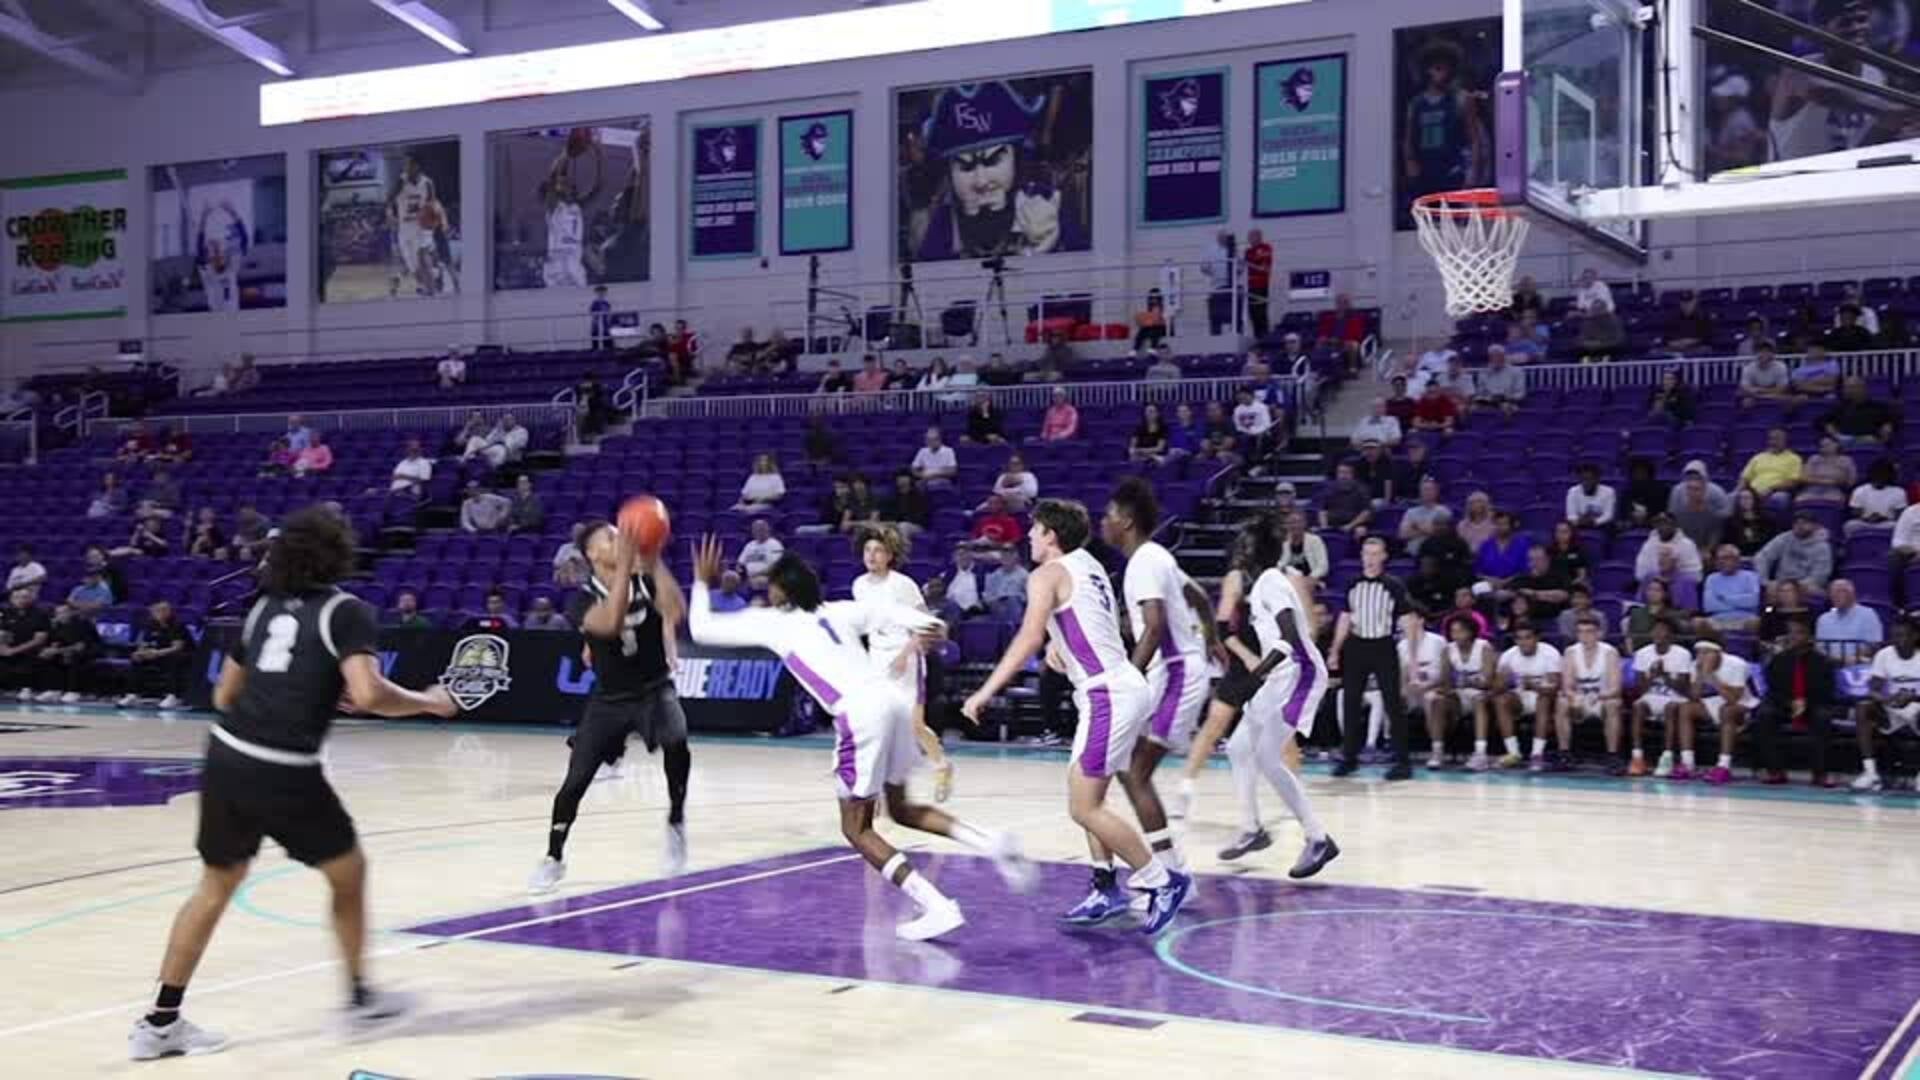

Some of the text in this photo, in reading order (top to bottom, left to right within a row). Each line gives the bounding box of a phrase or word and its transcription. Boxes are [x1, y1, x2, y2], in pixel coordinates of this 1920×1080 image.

[955, 102, 992, 133] FSW
[16, 237, 117, 268] ROOFING
[256, 614, 299, 673] 2
